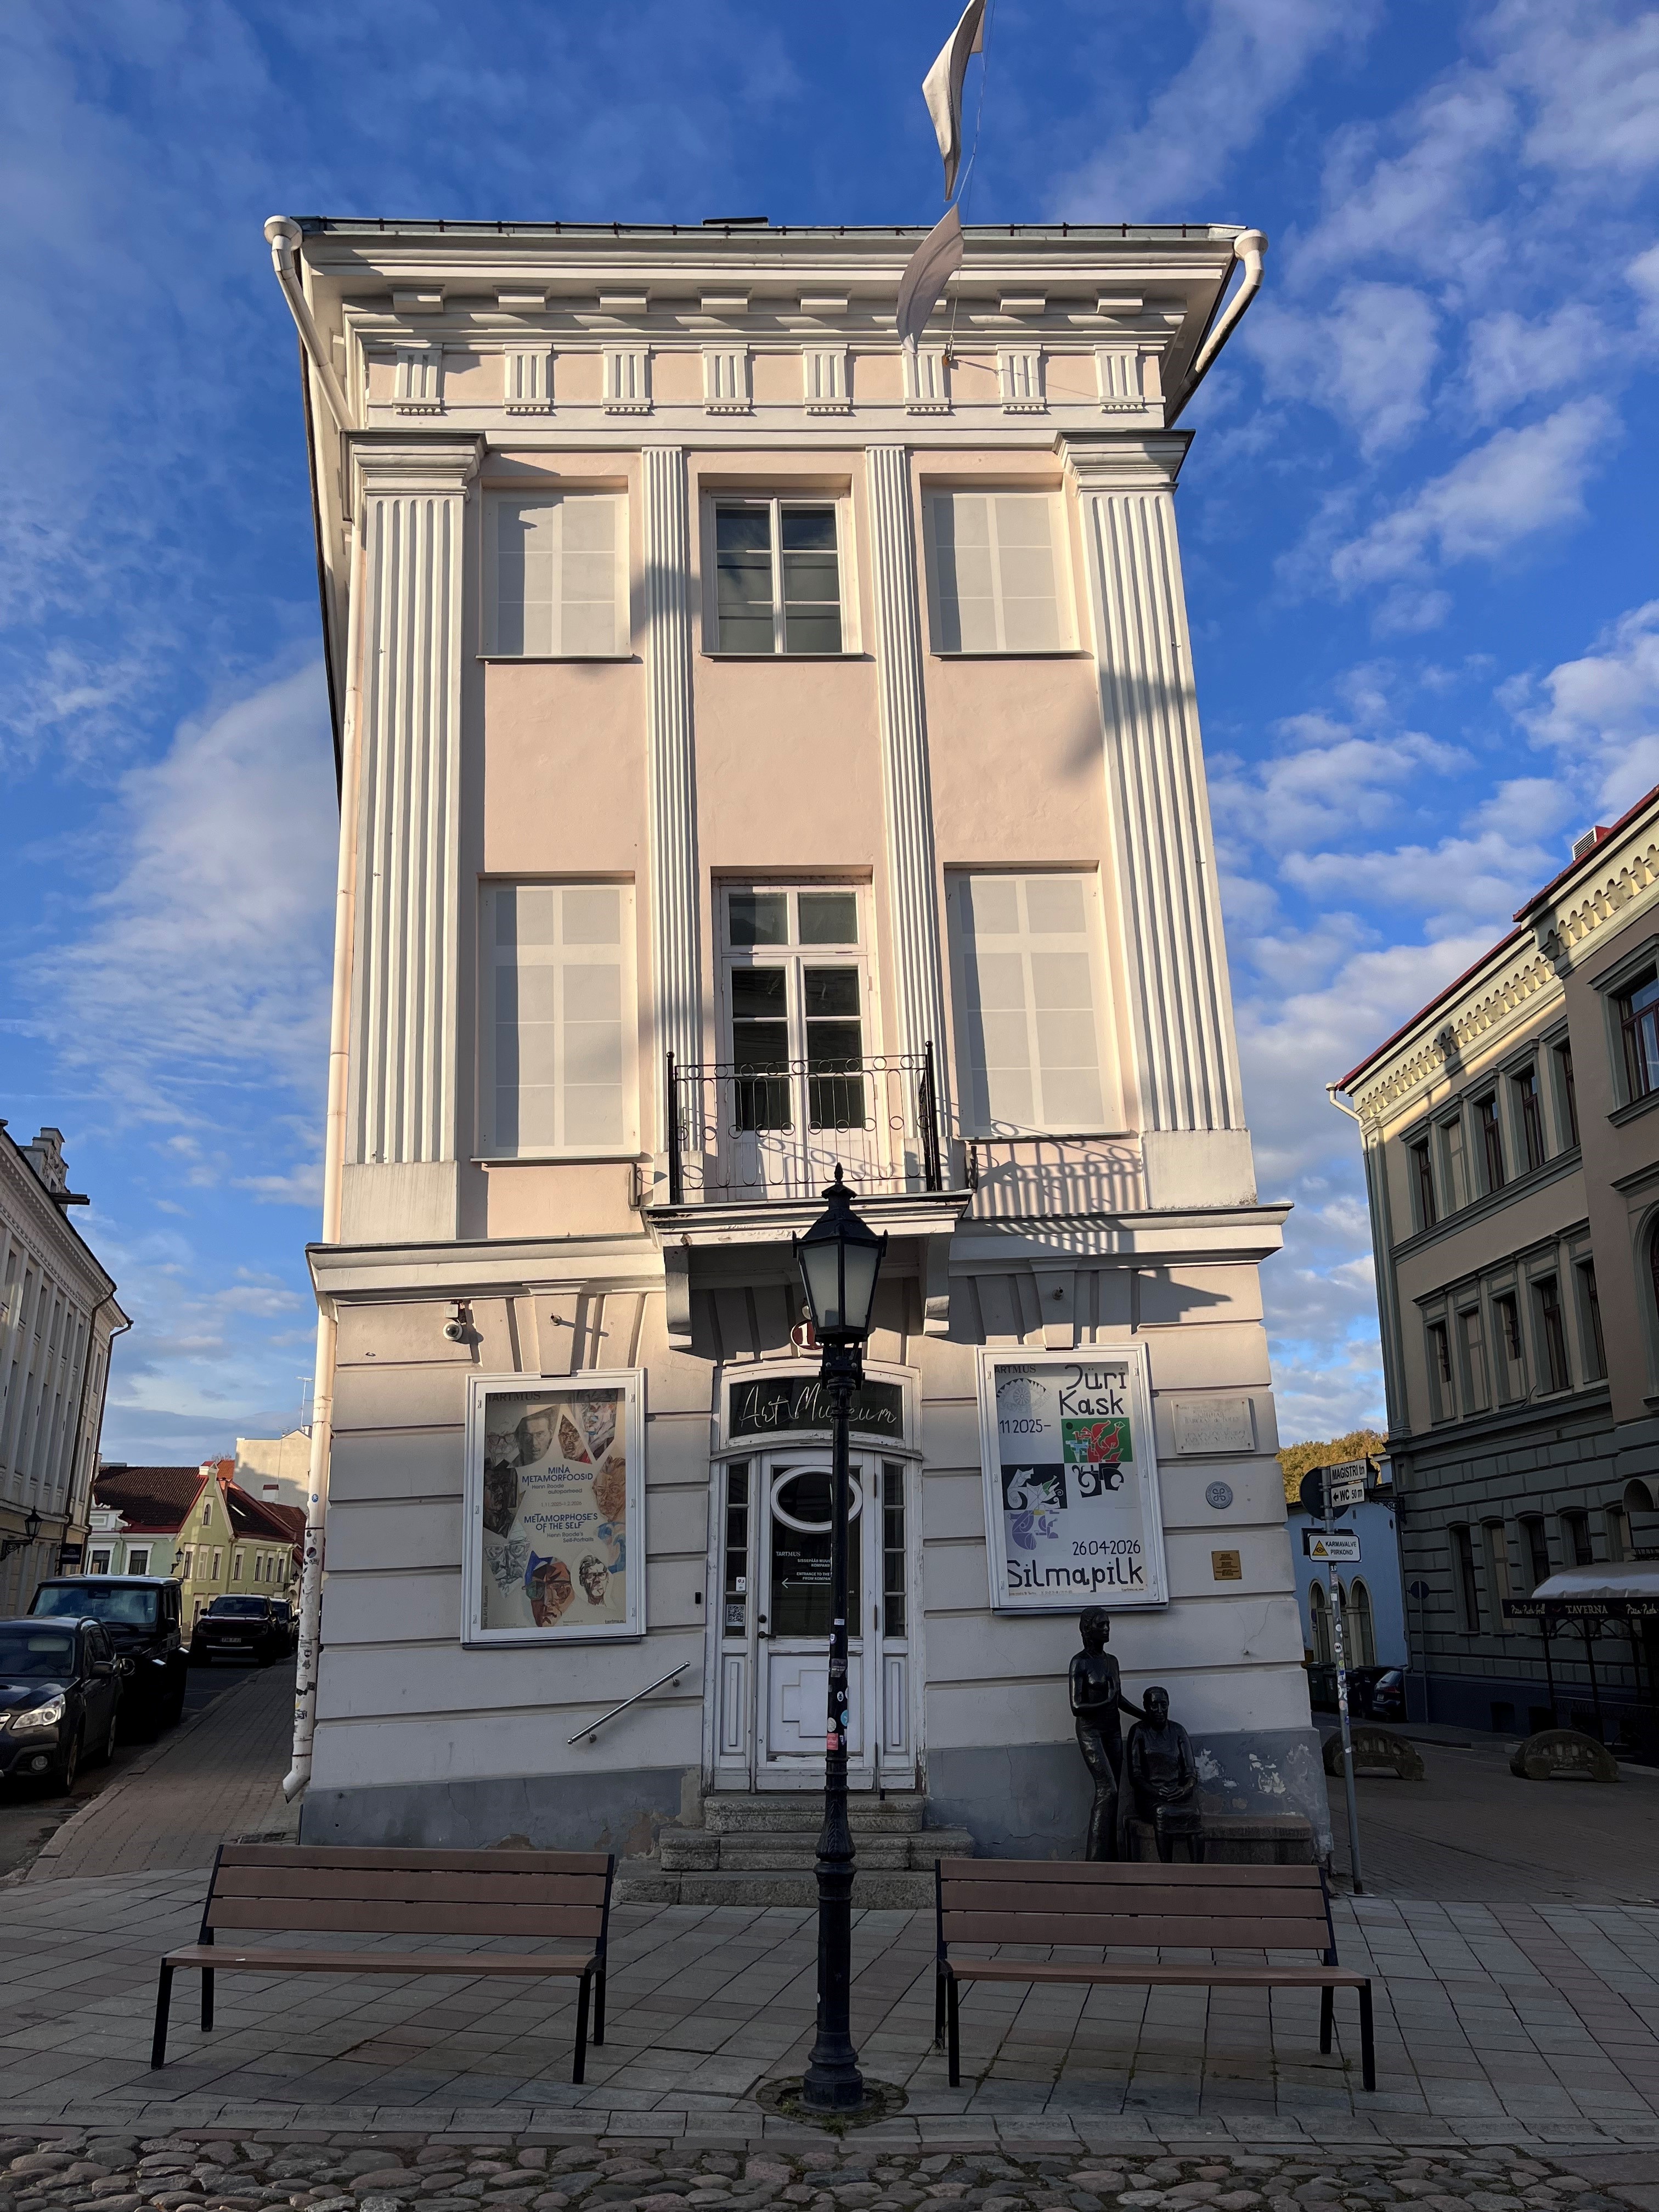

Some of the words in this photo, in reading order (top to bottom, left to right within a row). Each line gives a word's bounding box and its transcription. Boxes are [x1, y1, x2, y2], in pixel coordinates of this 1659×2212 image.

[1064, 1364, 1127, 1390] Jüri
[740, 1384, 790, 1428] Art
[1059, 1389, 1125, 1416] Kask
[548, 1464, 571, 1474] MINA
[1332, 1464, 1358, 1480] MAGISTRI
[1358, 1465, 1365, 1475] tn
[522, 1472, 593, 1486] METAMORFOOSID
[1339, 1489, 1350, 1502] WC
[1351, 1489, 1357, 1499] 50
[1357, 1489, 1363, 1498] m
[524, 1513, 598, 1523] METAMORPHOSES
[535, 1523, 547, 1533] OF
[565, 1521, 585, 1530] SELF
[1007, 1556, 1144, 1593] Silmapilk
[1565, 1605, 1609, 1614] TAVERNA
